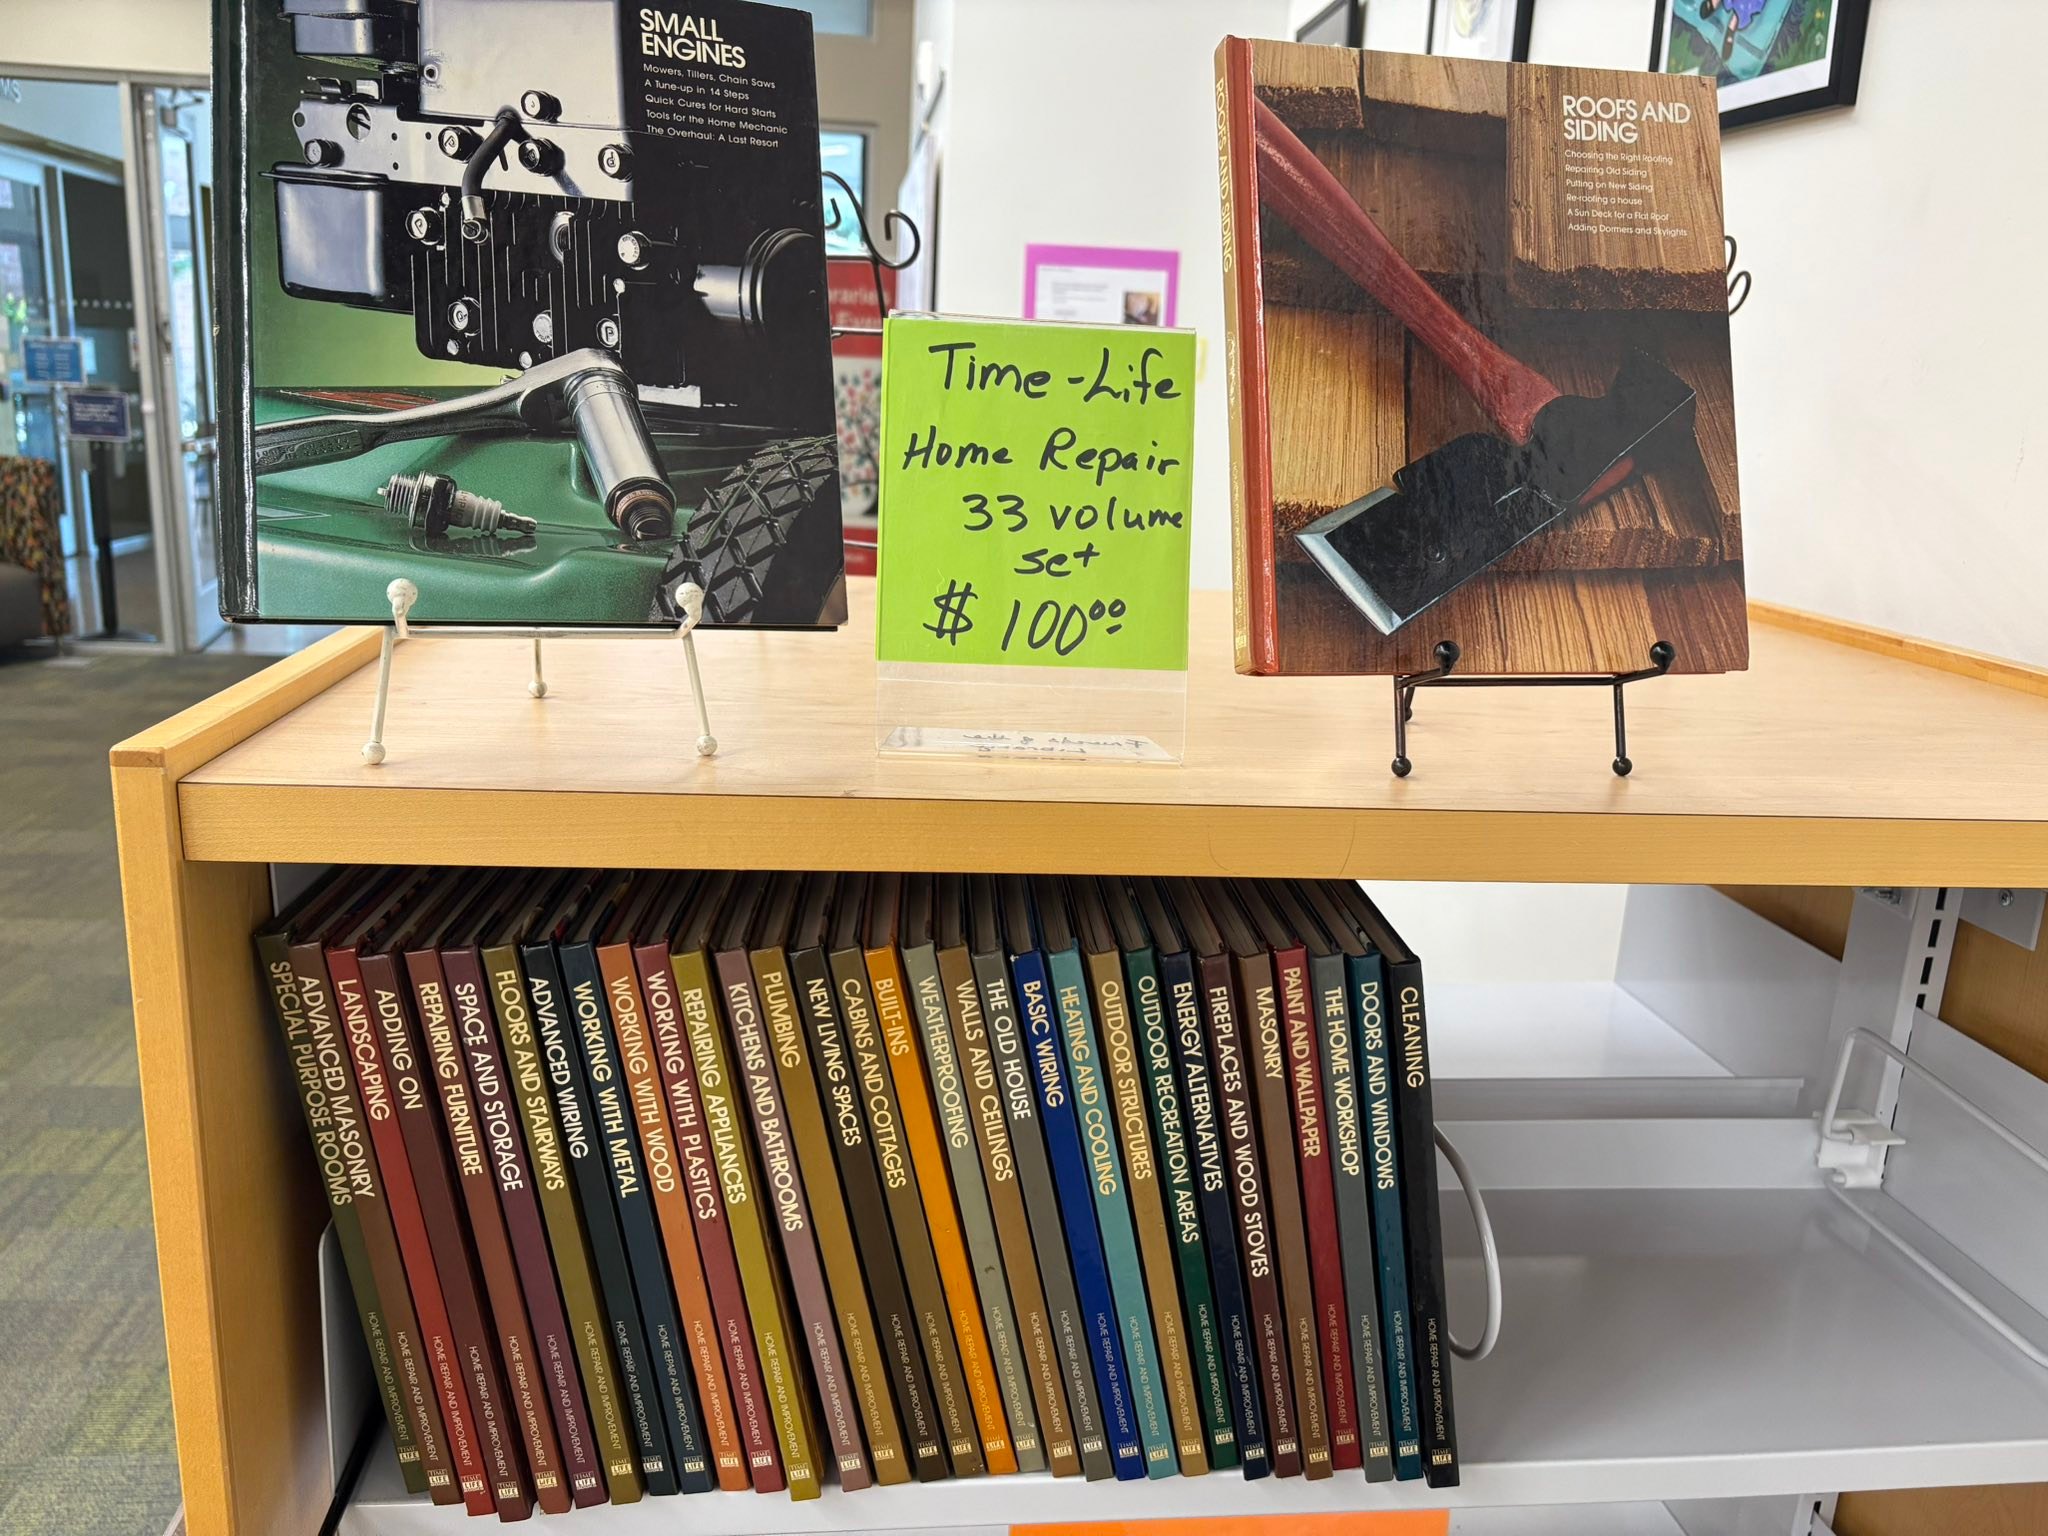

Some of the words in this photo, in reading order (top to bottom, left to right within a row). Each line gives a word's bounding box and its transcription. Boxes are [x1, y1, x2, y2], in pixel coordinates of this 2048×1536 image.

[639, 8, 724, 42] SMALL
[641, 32, 746, 69] ENGINES
[643, 63, 684, 77] Mowers,
[687, 69, 716, 82] Tillers,
[719, 73, 748, 85] Chain
[751, 79, 776, 89] Saws
[644, 79, 652, 87] A
[655, 80, 693, 94] Tune-up
[697, 86, 705, 94] in
[710, 88, 720, 96] 14
[723, 89, 750, 101] Steps
[645, 94, 674, 105] Quick
[678, 98, 706, 110] Cures
[709, 102, 722, 111] for
[724, 104, 748, 115] Hard
[751, 107, 777, 119] Starts
[646, 109, 670, 120] Tools
[673, 112, 686, 122] for
[689, 115, 704, 125] the
[707, 118, 736, 129] Home
[739, 121, 788, 134] Mechanic
[646, 125, 664, 135] The
[667, 127, 715, 140] Overhaul:
[718, 134, 725, 142] A
[728, 135, 747, 144] Last
[750, 137, 778, 148] Resort
[1216, 76, 1227, 151] ROOFS
[1562, 95, 1638, 120] ROOFS
[1641, 101, 1691, 123] AND
[1563, 118, 1638, 144] SIDING
[1219, 152, 1229, 199] AND
[1565, 150, 1604, 161] Choosing
[1621, 153, 1640, 162] Right
[1642, 155, 1673, 165] Roofing
[1565, 165, 1604, 175] Repairing
[1606, 166, 1620, 175] Old
[1622, 168, 1647, 178] Siding
[1566, 179, 1593, 190] Putting
[1609, 181, 1625, 189] New
[1628, 183, 1653, 192] Siding
[1566, 194, 1608, 205] Re-roofing
[1617, 196, 1642, 205] house
[1568, 223, 1597, 234] Adding
[1599, 225, 1633, 234] Dormers
[1635, 226, 1651, 234] and
[1653, 226, 1687, 237] Skylights
[1574, 209, 1589, 217] Sun
[1592, 209, 1612, 218] Deck
[1614, 210, 1625, 219] for
[1635, 212, 1650, 220] Flat
[1651, 213, 1669, 221] Roof
[1221, 200, 1232, 273] SIDING
[902, 425, 1014, 471] Home
[1039, 427, 1181, 487] Repair
[963, 494, 1028, 533] 33
[1050, 496, 1184, 532] volume
[1014, 542, 1100, 578] set
[455, 982, 488, 1047] SPACE
[495, 969, 531, 1046] FLOORS
[762, 971, 800, 1068] PLUMBING
[806, 978, 832, 1018] NEW
[842, 979, 874, 1049] CABINS
[875, 978, 910, 1057] BUILT-INS
[955, 979, 984, 1041] WALLS
[986, 978, 1009, 1011] THE
[1023, 980, 1049, 1036] BASIC
[1173, 981, 1203, 1057] ENERGY
[1283, 966, 1305, 1015] PAINT
[1324, 986, 1344, 1017] THE
[1360, 981, 1382, 1051] DOORS
[338, 979, 390, 1120] LANDSCAPING
[374, 989, 412, 1071] ADDING
[399, 1077, 423, 1110] ON
[573, 980, 612, 1082] WORKING
[611, 976, 648, 1075] WORKING
[647, 970, 685, 1074] WORKING
[728, 982, 766, 1072] KITCHENS
[817, 1022, 846, 1082] LIVING
[994, 1016, 1017, 1054] OLD
[1060, 986, 1090, 1062] HEATING
[1209, 986, 1242, 1093] FIREPLACES
[1256, 986, 1283, 1079] MASONRY
[1289, 1019, 1309, 1059] AND
[1328, 1020, 1349, 1075] HOME
[1400, 986, 1425, 1088] CLEANING
[270, 961, 308, 1040] SPECIAL
[292, 1043, 332, 1127] PURPOSE
[316, 1130, 353, 1205] ROOMS
[298, 976, 346, 1091] ADVANCED
[330, 1094, 375, 1197] MASONRY
[418, 982, 459, 1079] REPAIRING
[444, 1084, 483, 1176] FURNITURE
[471, 1052, 499, 1096] AND
[514, 1050, 541, 1092] AND
[529, 977, 571, 1085] ADVANCED
[556, 1087, 589, 1159] WIRING
[858, 1052, 884, 1093] AND
[918, 975, 969, 1149] WEATHERPROOFING
[969, 1048, 994, 1089] AND
[1003, 1058, 1032, 1120] HOUSE
[1035, 1038, 1064, 1107] WIRING
[1075, 1065, 1098, 1105] AND
[1101, 980, 1133, 1074] OUTDOOR
[1118, 1078, 1152, 1180] STRUCTURES
[1366, 1055, 1386, 1095] AND
[598, 1087, 625, 1133] WITH
[634, 1078, 661, 1125] WITH
[671, 1079, 698, 1128] WITH
[682, 987, 721, 1088] REPAIRING
[705, 1094, 747, 1205] APPLIANCES
[750, 1075, 776, 1116] AND
[832, 1085, 862, 1147] SPACES
[1138, 975, 1169, 1071] OUTDOOR
[1155, 1074, 1190, 1184] RECREATION
[1174, 1189, 1199, 1243] AREAS
[1227, 1098, 1249, 1139] AND
[1294, 1060, 1321, 1158] WALLPAPER
[1334, 1076, 1360, 1176] WORKSHOP
[484, 1101, 524, 1192] STORAGE
[526, 1096, 565, 1191] STAIRWAYS
[870, 1095, 907, 1189] COTTAGES
[979, 1095, 1014, 1182] CEILINGS
[1085, 1108, 1117, 1196] COOLING
[1185, 1063, 1223, 1191] ALTERNATIVES
[1371, 1098, 1394, 1190] WINDOWS
[609, 1138, 640, 1198] METAL
[645, 1128, 675, 1193] WOOD
[682, 1134, 717, 1220] PLASTICS
[760, 1118, 803, 1232] BATHROOMS
[1234, 1143, 1259, 1208] WOOD
[1244, 1212, 1269, 1278] STOVES
[397, 1331, 411, 1357] HOME
[403, 1357, 418, 1387] REPAIR
[411, 1386, 423, 1405] AND
[416, 1404, 439, 1462] IMPROVEMENT
[429, 1474, 450, 1483] LIFE
